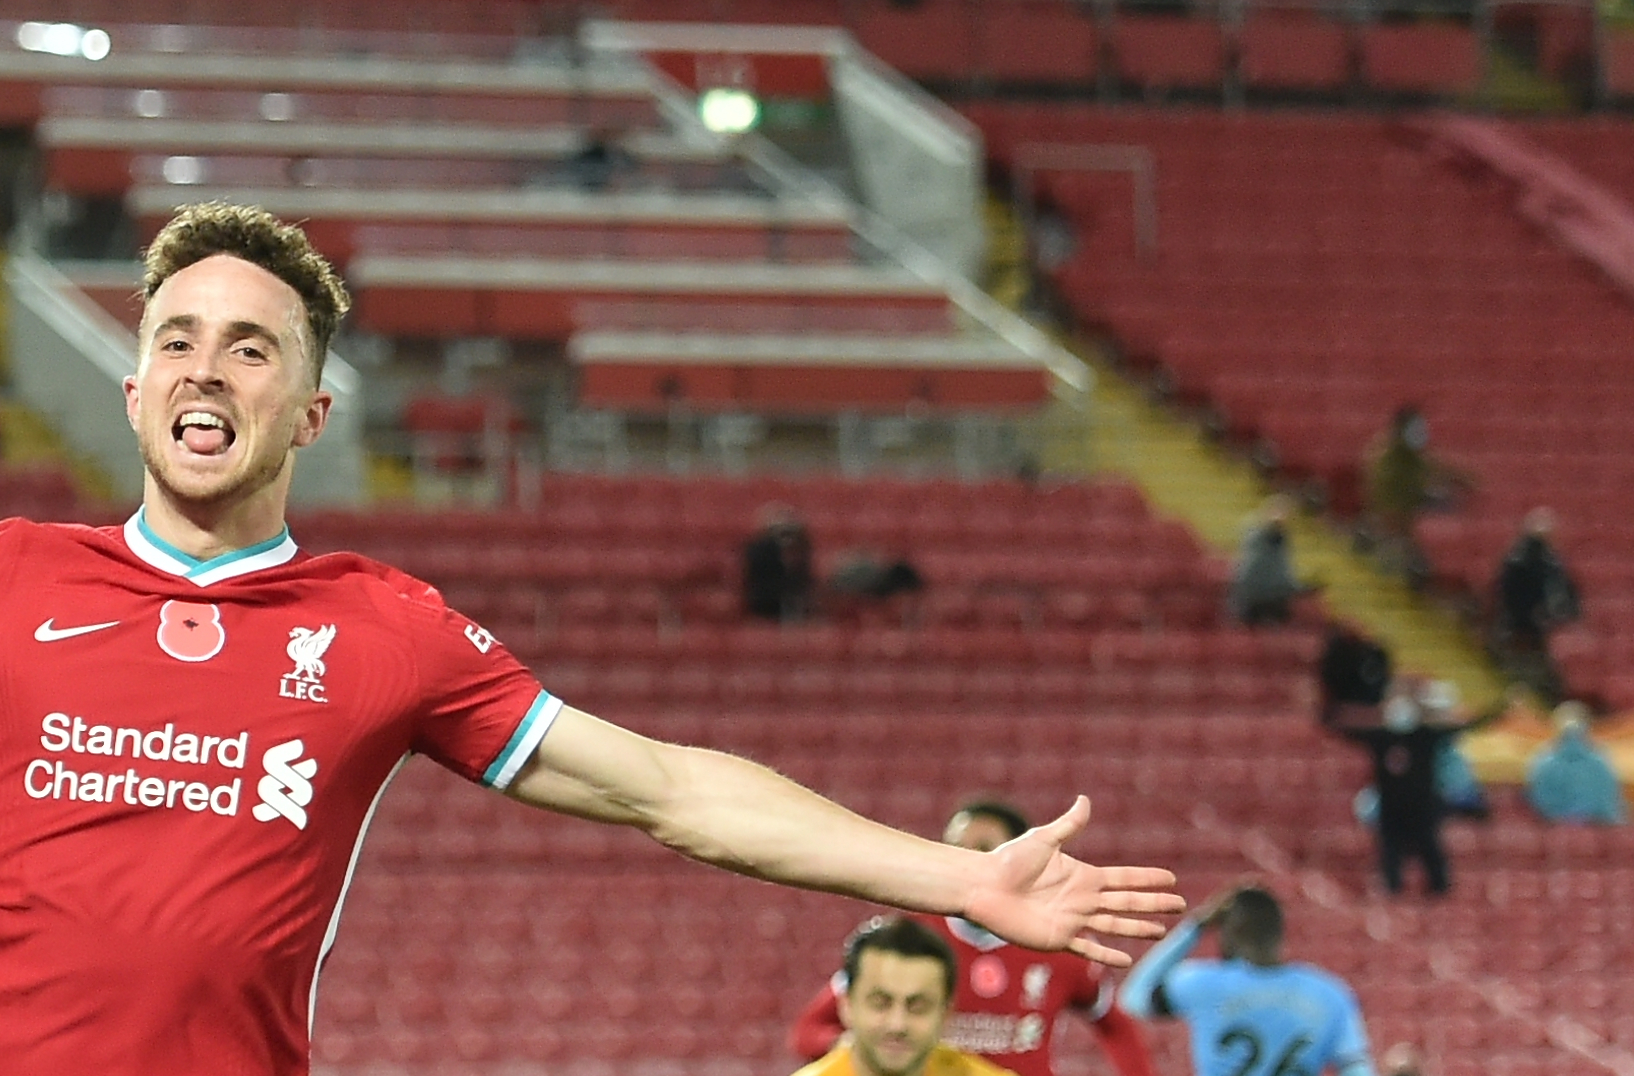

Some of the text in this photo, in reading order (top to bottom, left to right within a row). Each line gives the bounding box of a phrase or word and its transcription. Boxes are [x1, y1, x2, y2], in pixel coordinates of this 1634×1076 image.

[279, 678, 329, 703] L.F.C.
[40, 712, 248, 769] Standard
[24, 759, 241, 816] Chartered
